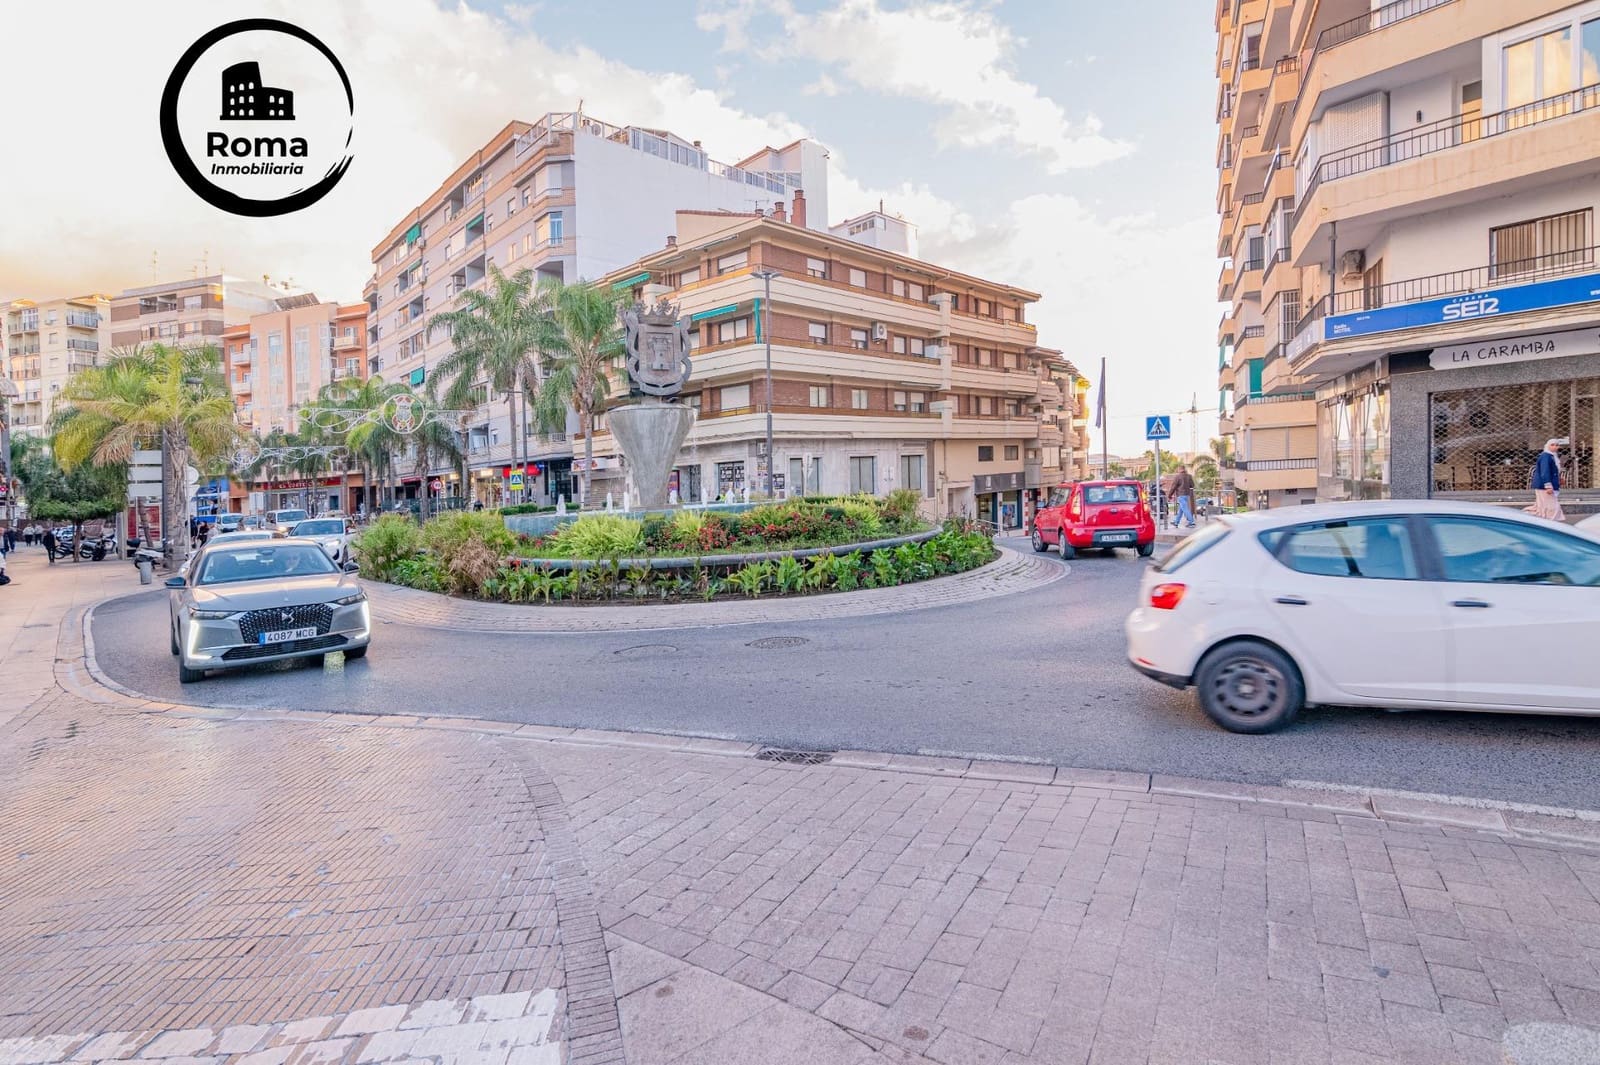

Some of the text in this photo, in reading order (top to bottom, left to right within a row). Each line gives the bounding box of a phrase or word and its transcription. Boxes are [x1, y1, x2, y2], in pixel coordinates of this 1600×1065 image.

[1442, 297, 1500, 320] SER
[1452, 340, 1555, 362] LA CARAMBA
[267, 631, 293, 641] 4087
